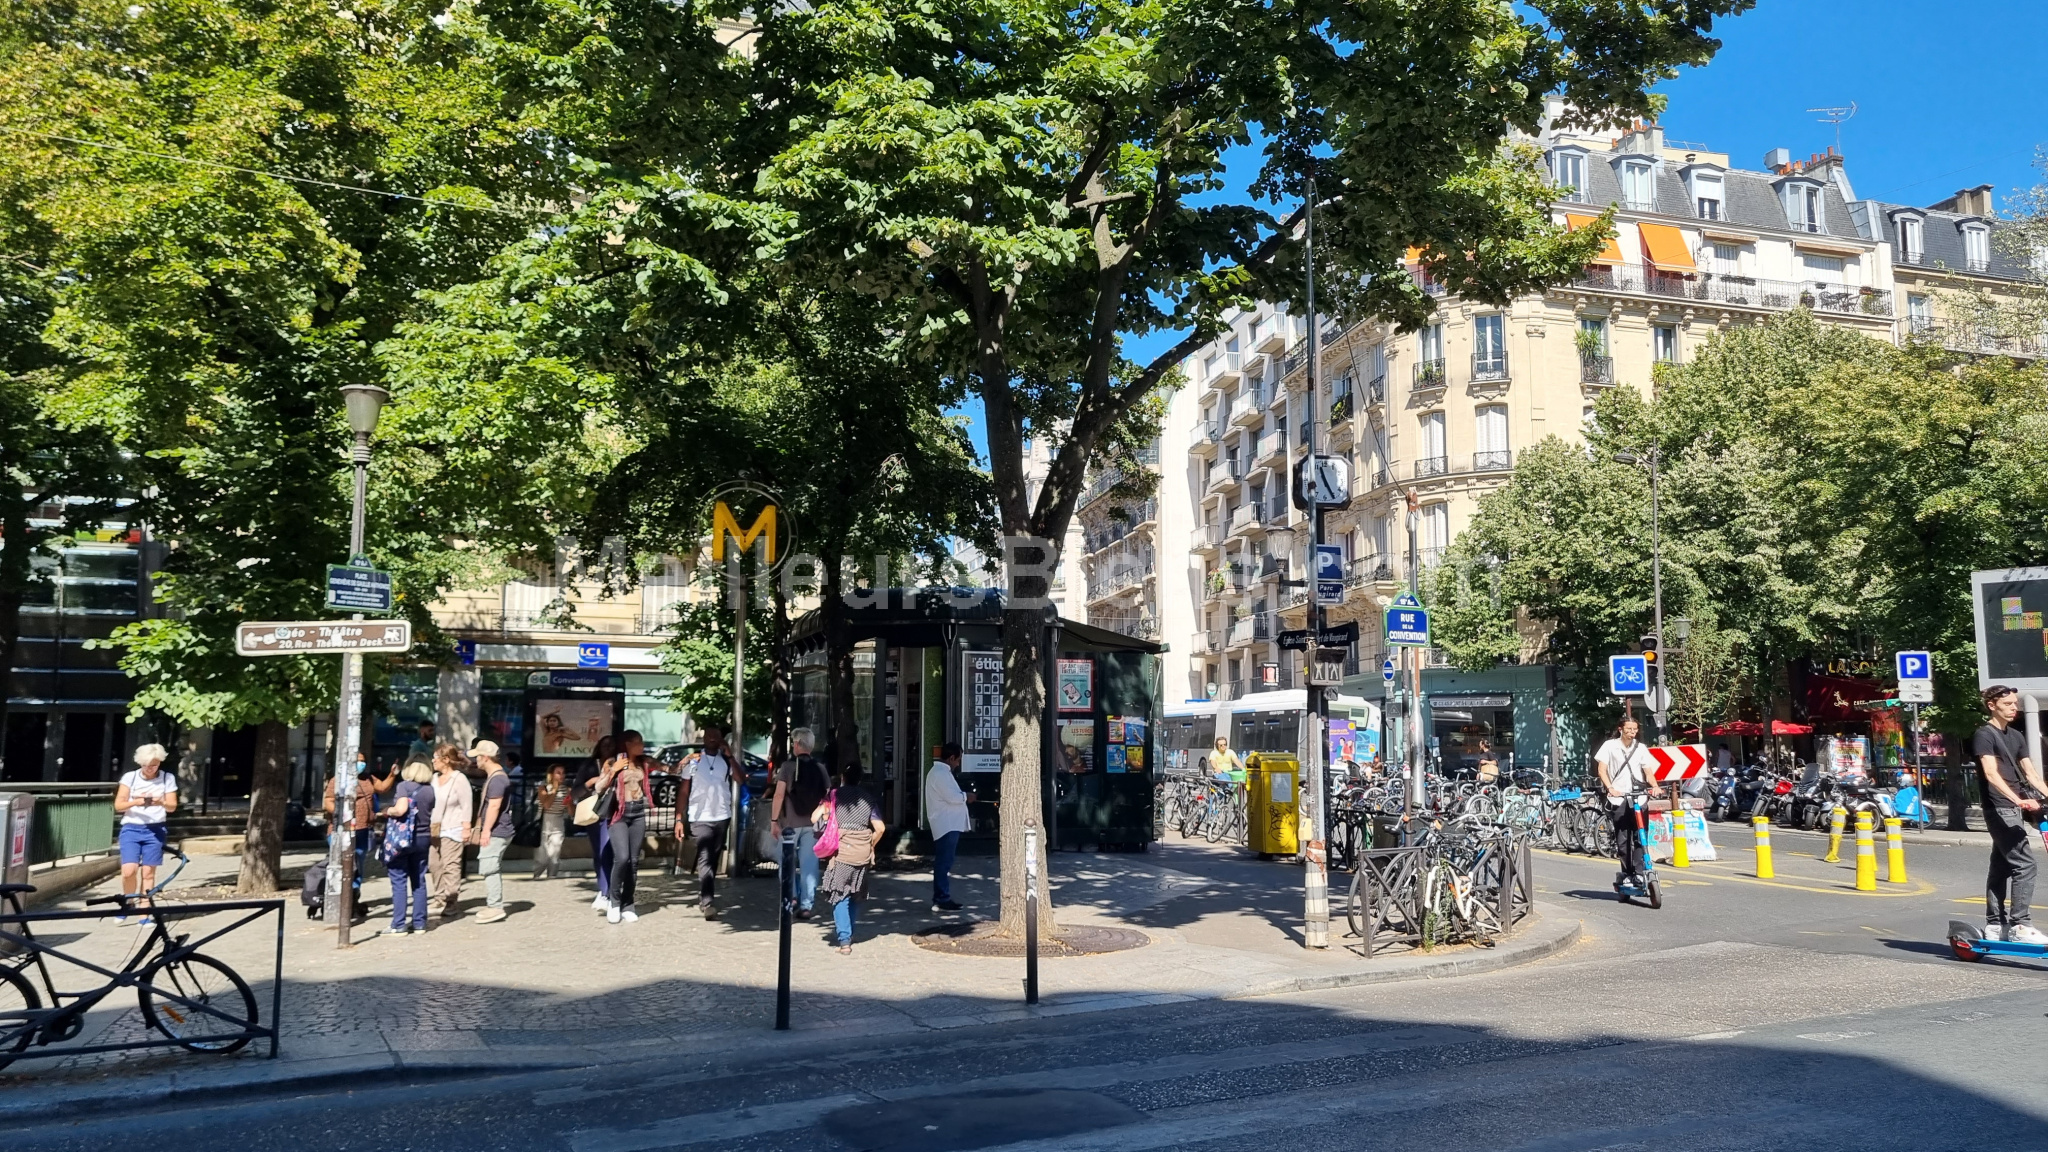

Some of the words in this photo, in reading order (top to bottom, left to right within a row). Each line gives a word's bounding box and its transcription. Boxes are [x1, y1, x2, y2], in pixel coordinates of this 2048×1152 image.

[712, 501, 776, 564] M
[1318, 552, 1334, 573] P
[1318, 588, 1342, 598] ugirard
[1400, 613, 1415, 623] RUE
[1389, 631, 1426, 641] CONVENTION
[360, 637, 383, 646] Deck
[580, 647, 605, 657] LCL
[1906, 657, 1921, 675] P
[552, 676, 596, 684] Convention
